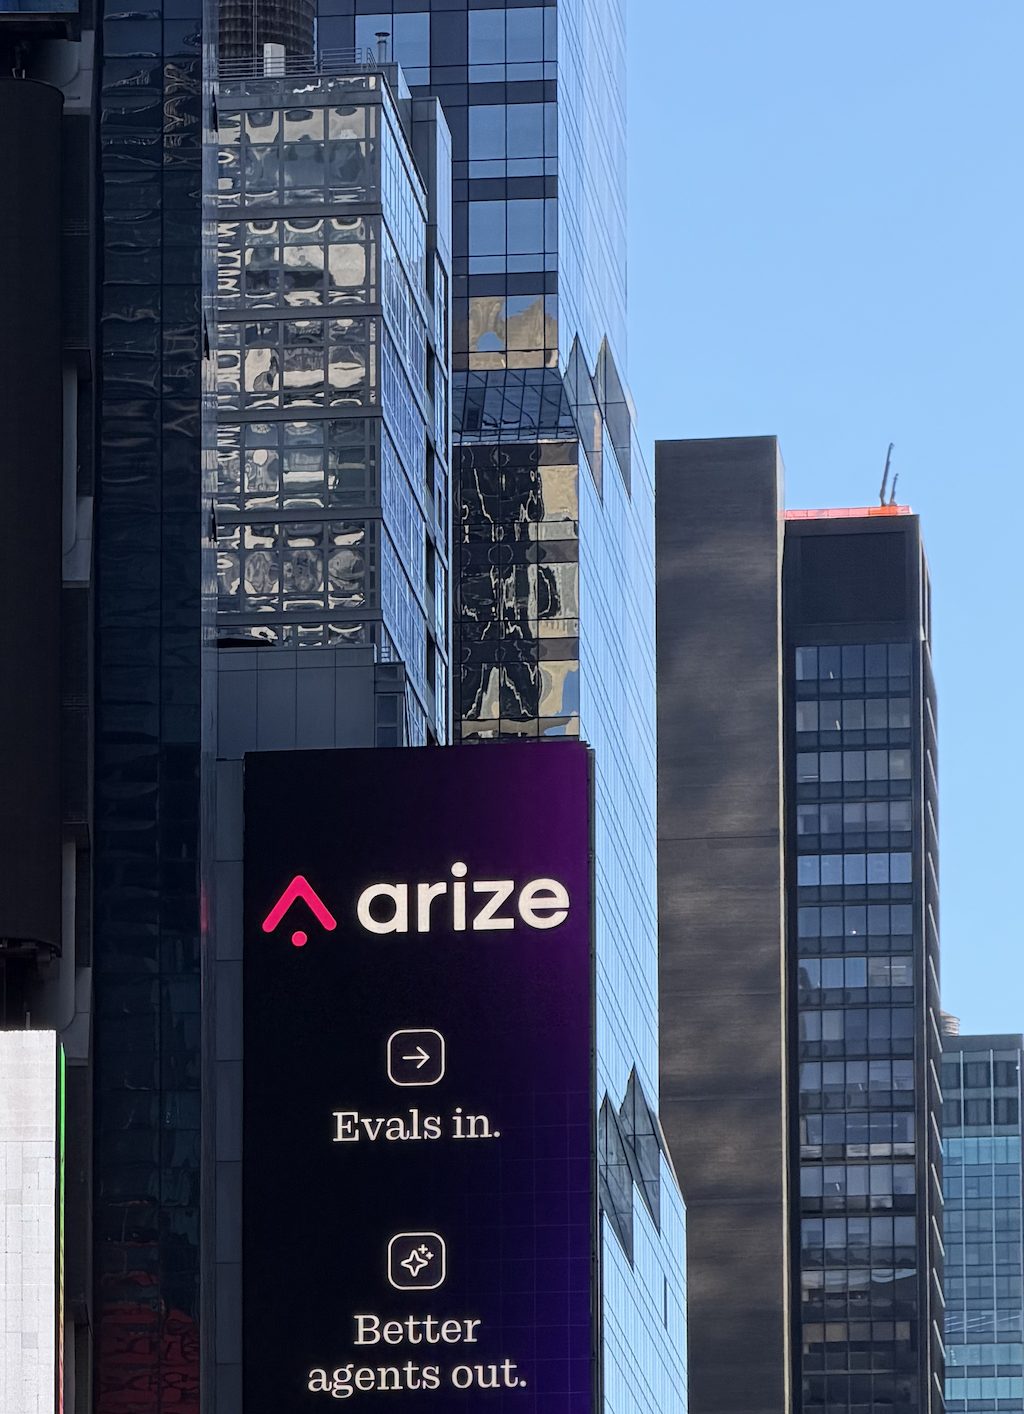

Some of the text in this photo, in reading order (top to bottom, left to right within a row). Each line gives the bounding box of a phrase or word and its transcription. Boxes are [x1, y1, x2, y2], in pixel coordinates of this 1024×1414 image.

[357, 861, 570, 934] arize
[332, 1107, 501, 1142] Evals in.
[353, 1315, 481, 1346] Better
[308, 1358, 527, 1398] agents out.
